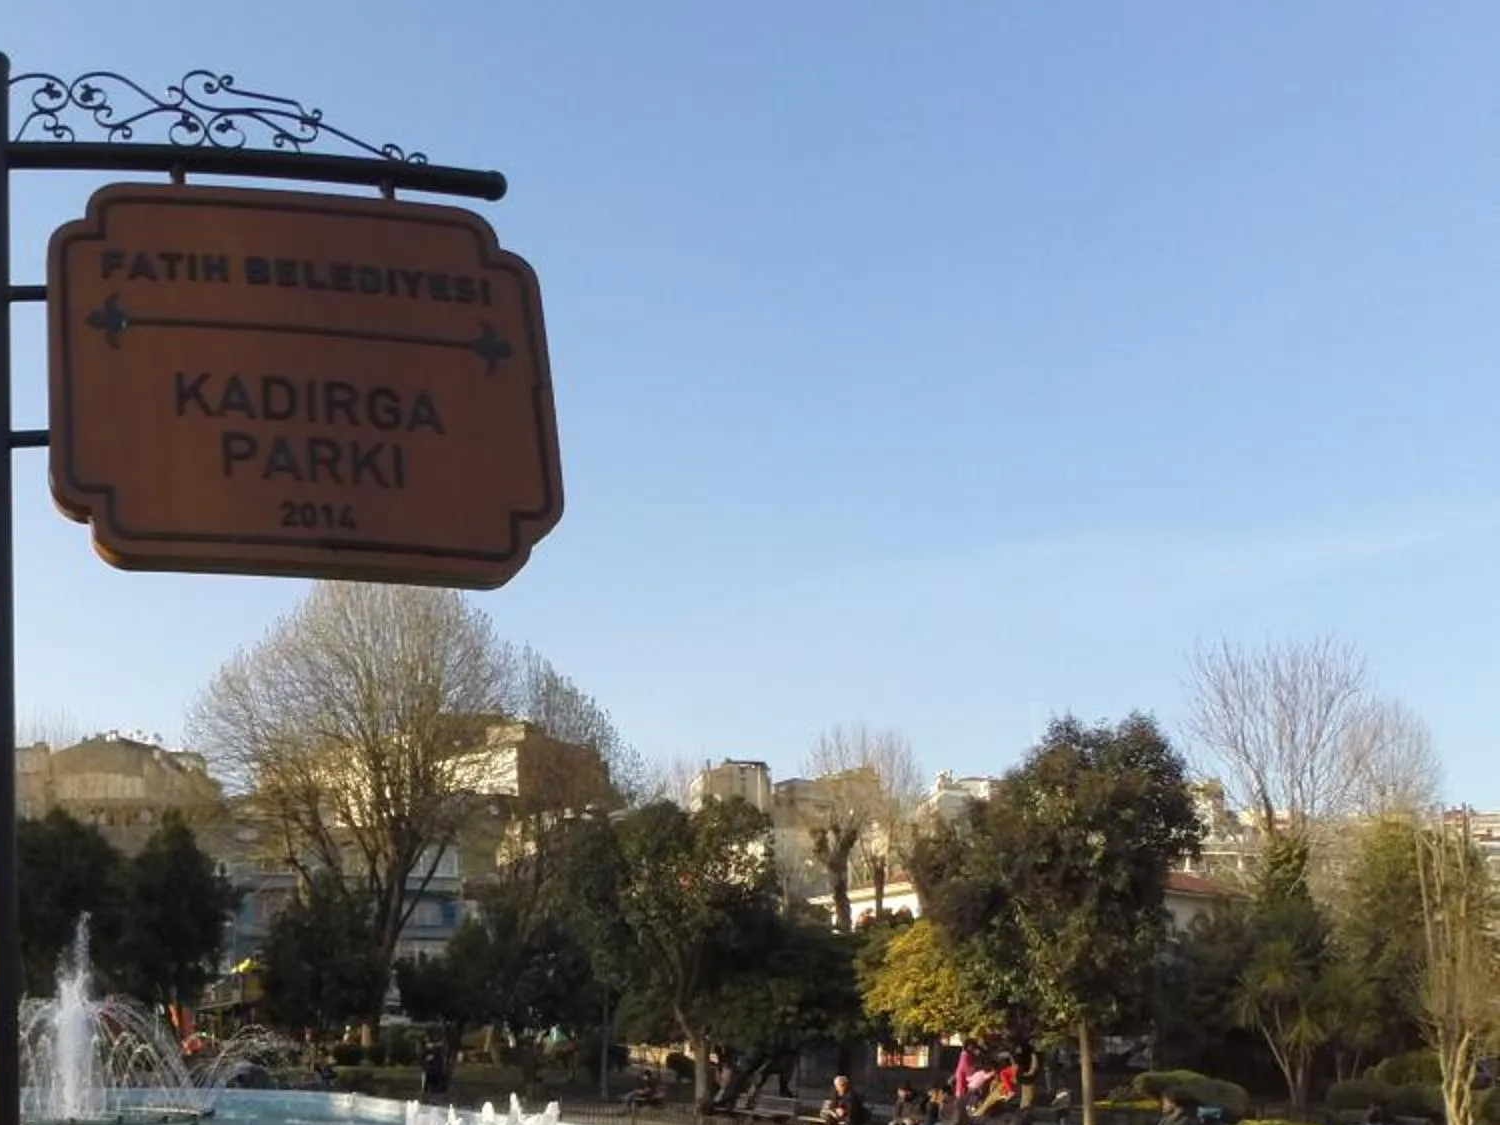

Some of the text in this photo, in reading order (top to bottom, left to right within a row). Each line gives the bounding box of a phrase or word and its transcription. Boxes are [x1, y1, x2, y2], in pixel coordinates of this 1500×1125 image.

[174, 370, 446, 435] KADIRGA
[221, 430, 406, 489] PARKI
[279, 500, 358, 531] 2014
